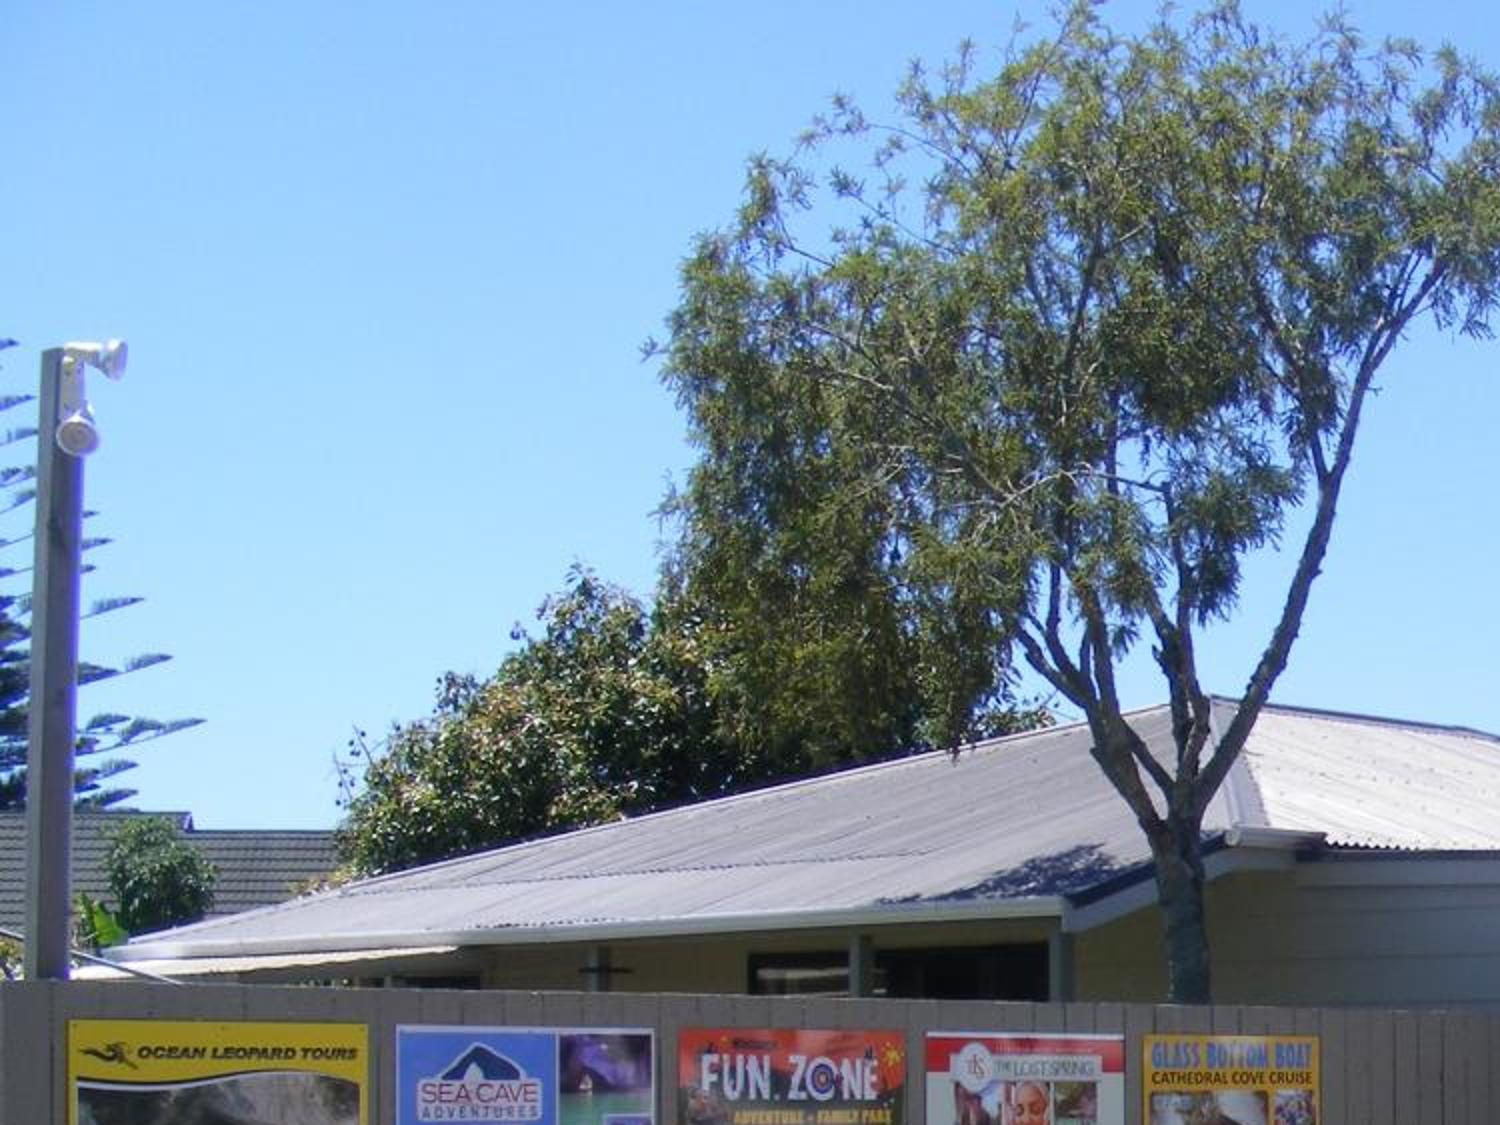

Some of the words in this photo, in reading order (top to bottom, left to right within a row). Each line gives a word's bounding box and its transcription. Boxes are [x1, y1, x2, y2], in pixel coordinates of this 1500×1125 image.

[137, 1045, 205, 1060] OCEAN
[210, 1046, 297, 1060] LEOPARD
[300, 1047, 359, 1061] TOURS
[1151, 1041, 1201, 1069] GLASS
[1151, 1071, 1229, 1085] CATHEDRAL
[1231, 1071, 1265, 1085] COVE
[1268, 1071, 1313, 1085] CRUISE
[421, 1083, 472, 1103] SEA
[475, 1083, 539, 1103] CAVE
[421, 1105, 538, 1119] ADVENTURES
